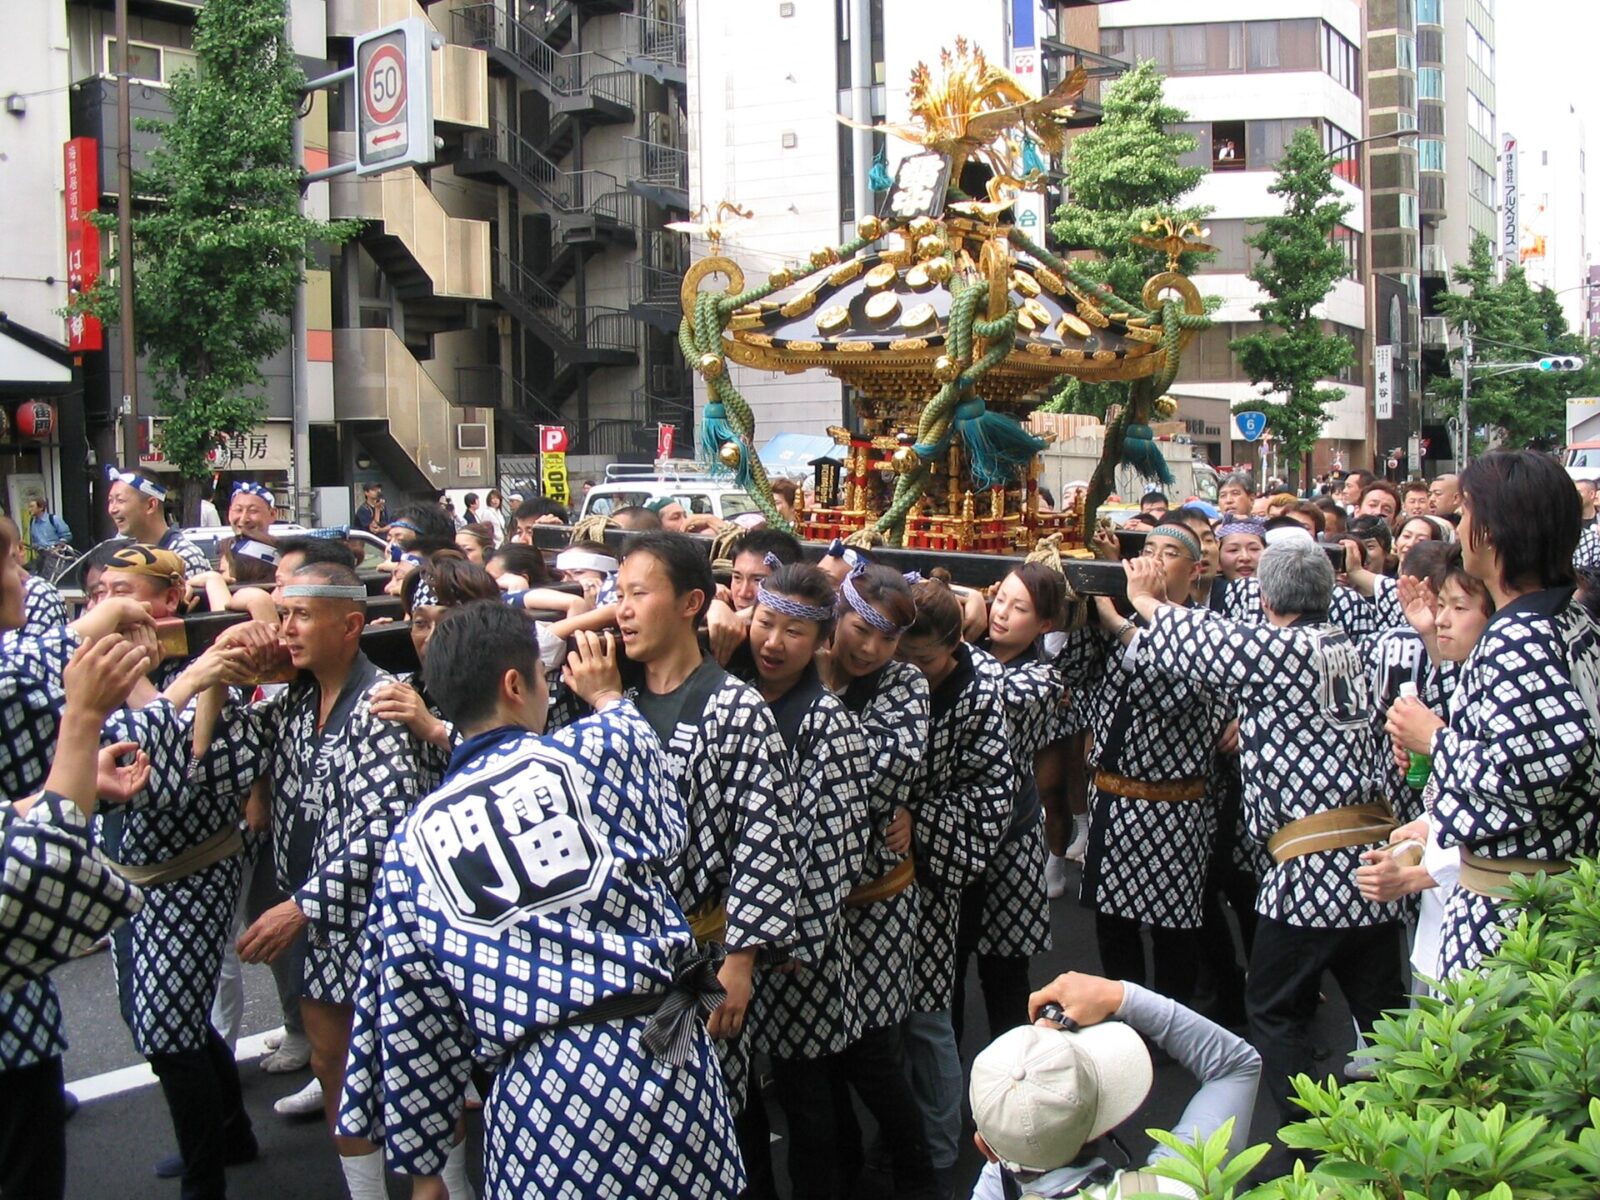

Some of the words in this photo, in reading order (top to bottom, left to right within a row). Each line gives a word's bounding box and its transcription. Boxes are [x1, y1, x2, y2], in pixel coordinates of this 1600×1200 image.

[373, 66, 397, 103] 50
[1378, 372, 1388, 413] 長谷川
[546, 430, 562, 450] P
[1246, 419, 1255, 430] 6
[548, 471, 565, 502] OPE
